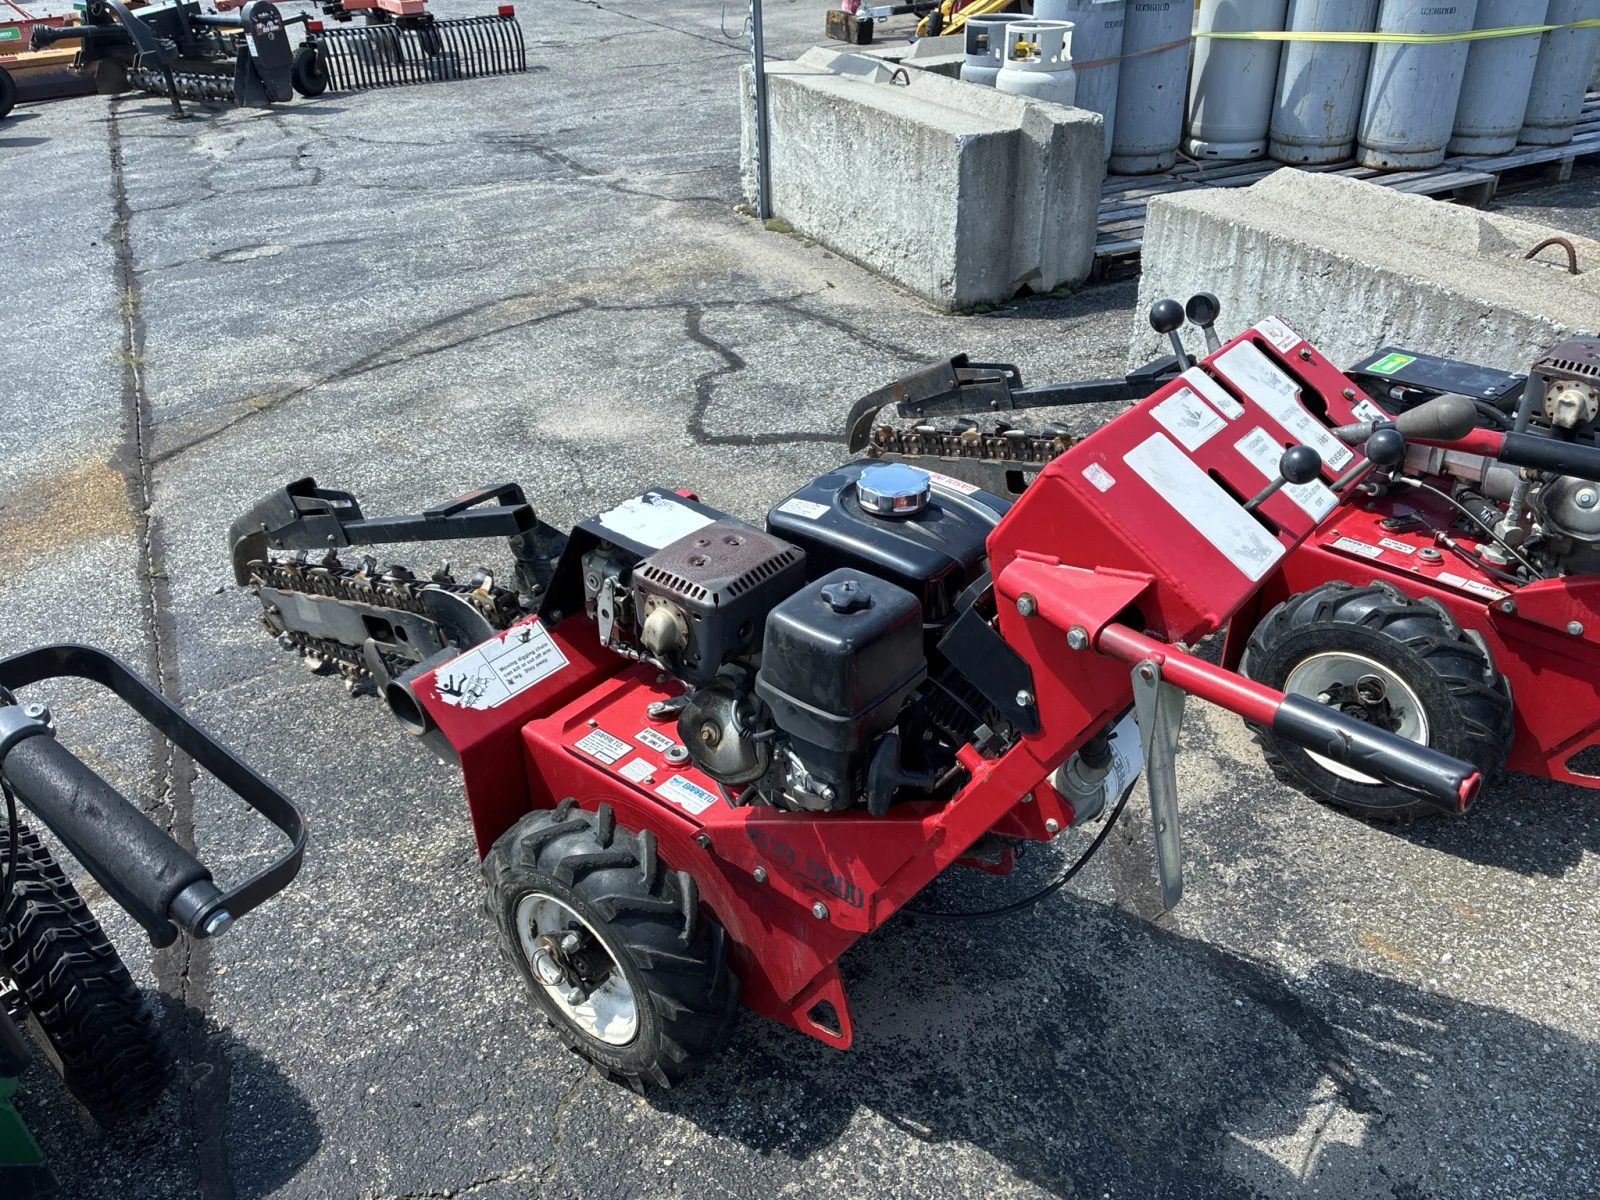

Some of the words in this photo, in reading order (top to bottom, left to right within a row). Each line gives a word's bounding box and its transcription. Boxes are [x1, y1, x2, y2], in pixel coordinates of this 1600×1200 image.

[1135, 2, 1170, 11] 0336000
[1421, 6, 1457, 16] 0336000
[1317, 433, 1330, 446] FAST
[1328, 447, 1348, 466] REVERSE
[1315, 497, 1325, 507] OFF
[499, 660, 517, 672] Moving
[517, 651, 536, 662] digging
[535, 642, 548, 652] chain
[524, 665, 535, 674] Stay
[593, 728, 623, 748] BARRETO
[682, 781, 717, 804] BARRETO
